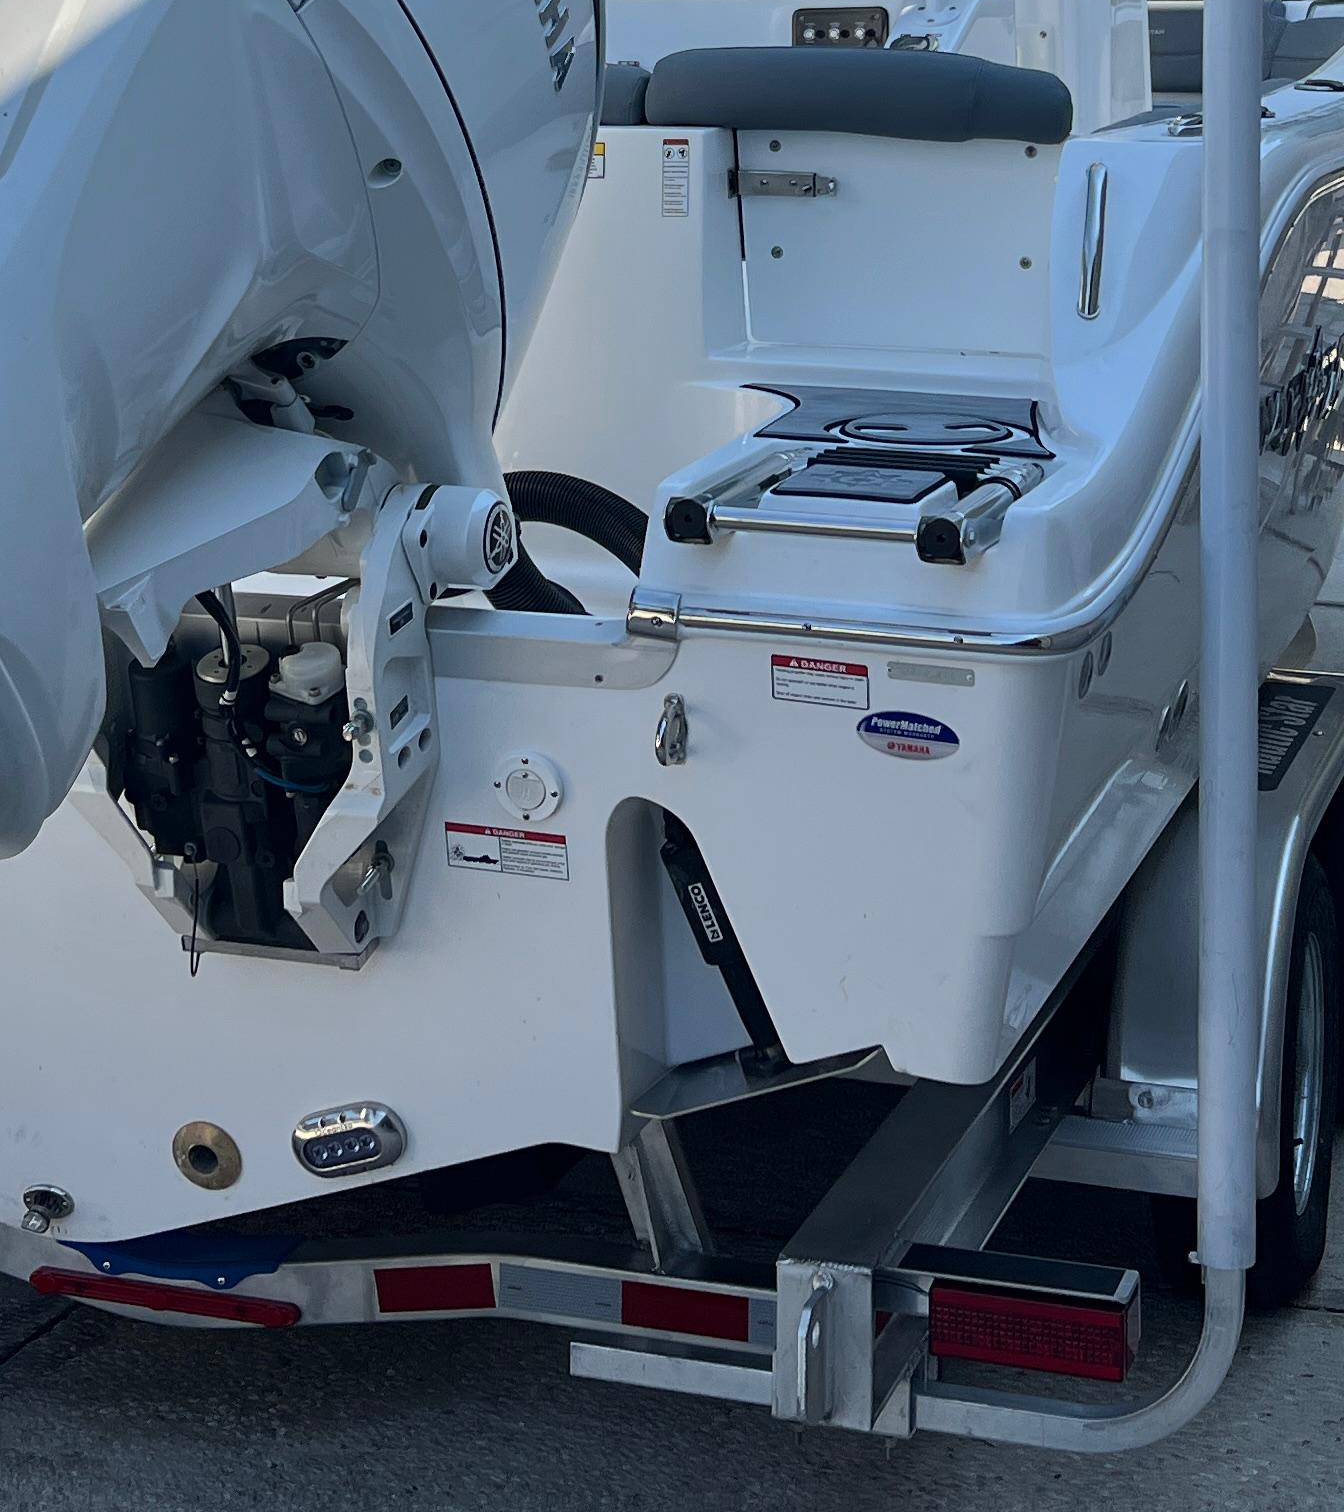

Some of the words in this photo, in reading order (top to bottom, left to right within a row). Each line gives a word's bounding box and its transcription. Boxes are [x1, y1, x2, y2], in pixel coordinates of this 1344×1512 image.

[801, 660, 847, 673] DANGER
[896, 742, 930, 754] YAMAHA
[690, 885, 717, 930] LENCO
